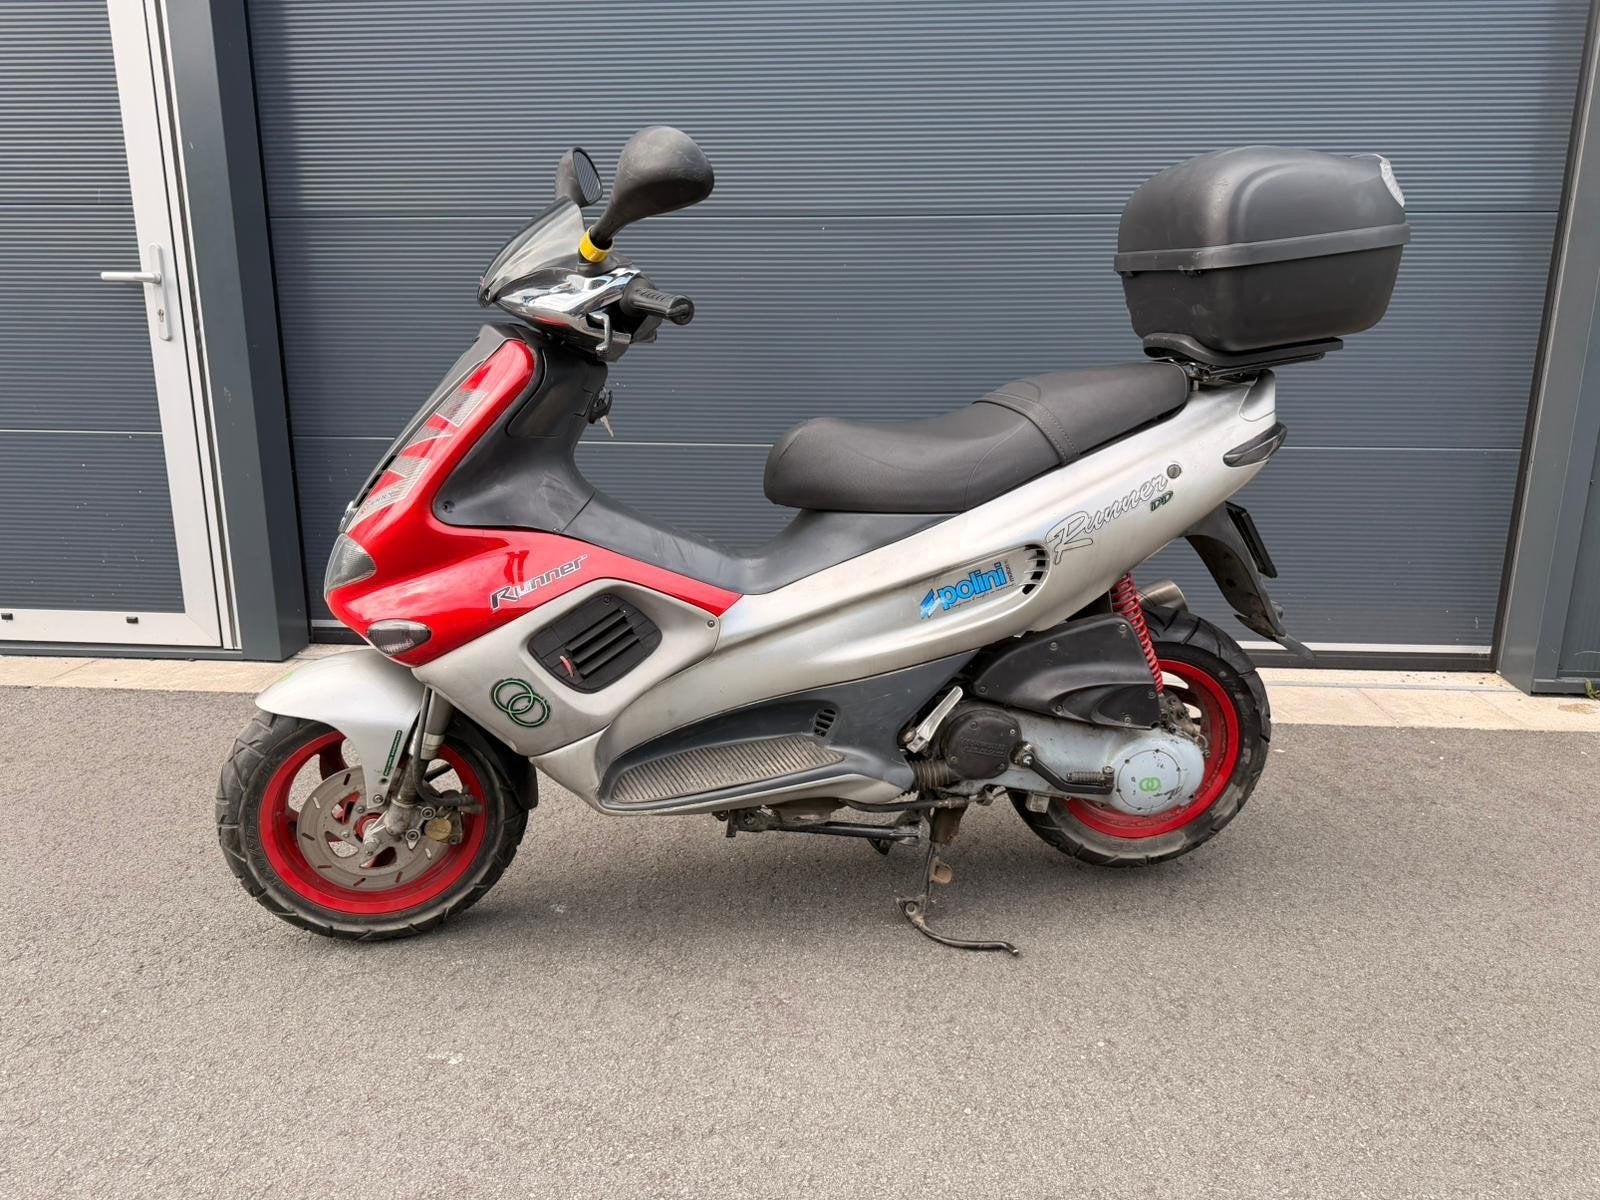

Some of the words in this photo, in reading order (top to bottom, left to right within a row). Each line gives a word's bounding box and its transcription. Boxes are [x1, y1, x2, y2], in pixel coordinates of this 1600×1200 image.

[1044, 473, 1168, 565] Runner
[490, 553, 588, 613] Runner
[936, 561, 1008, 611] polini
